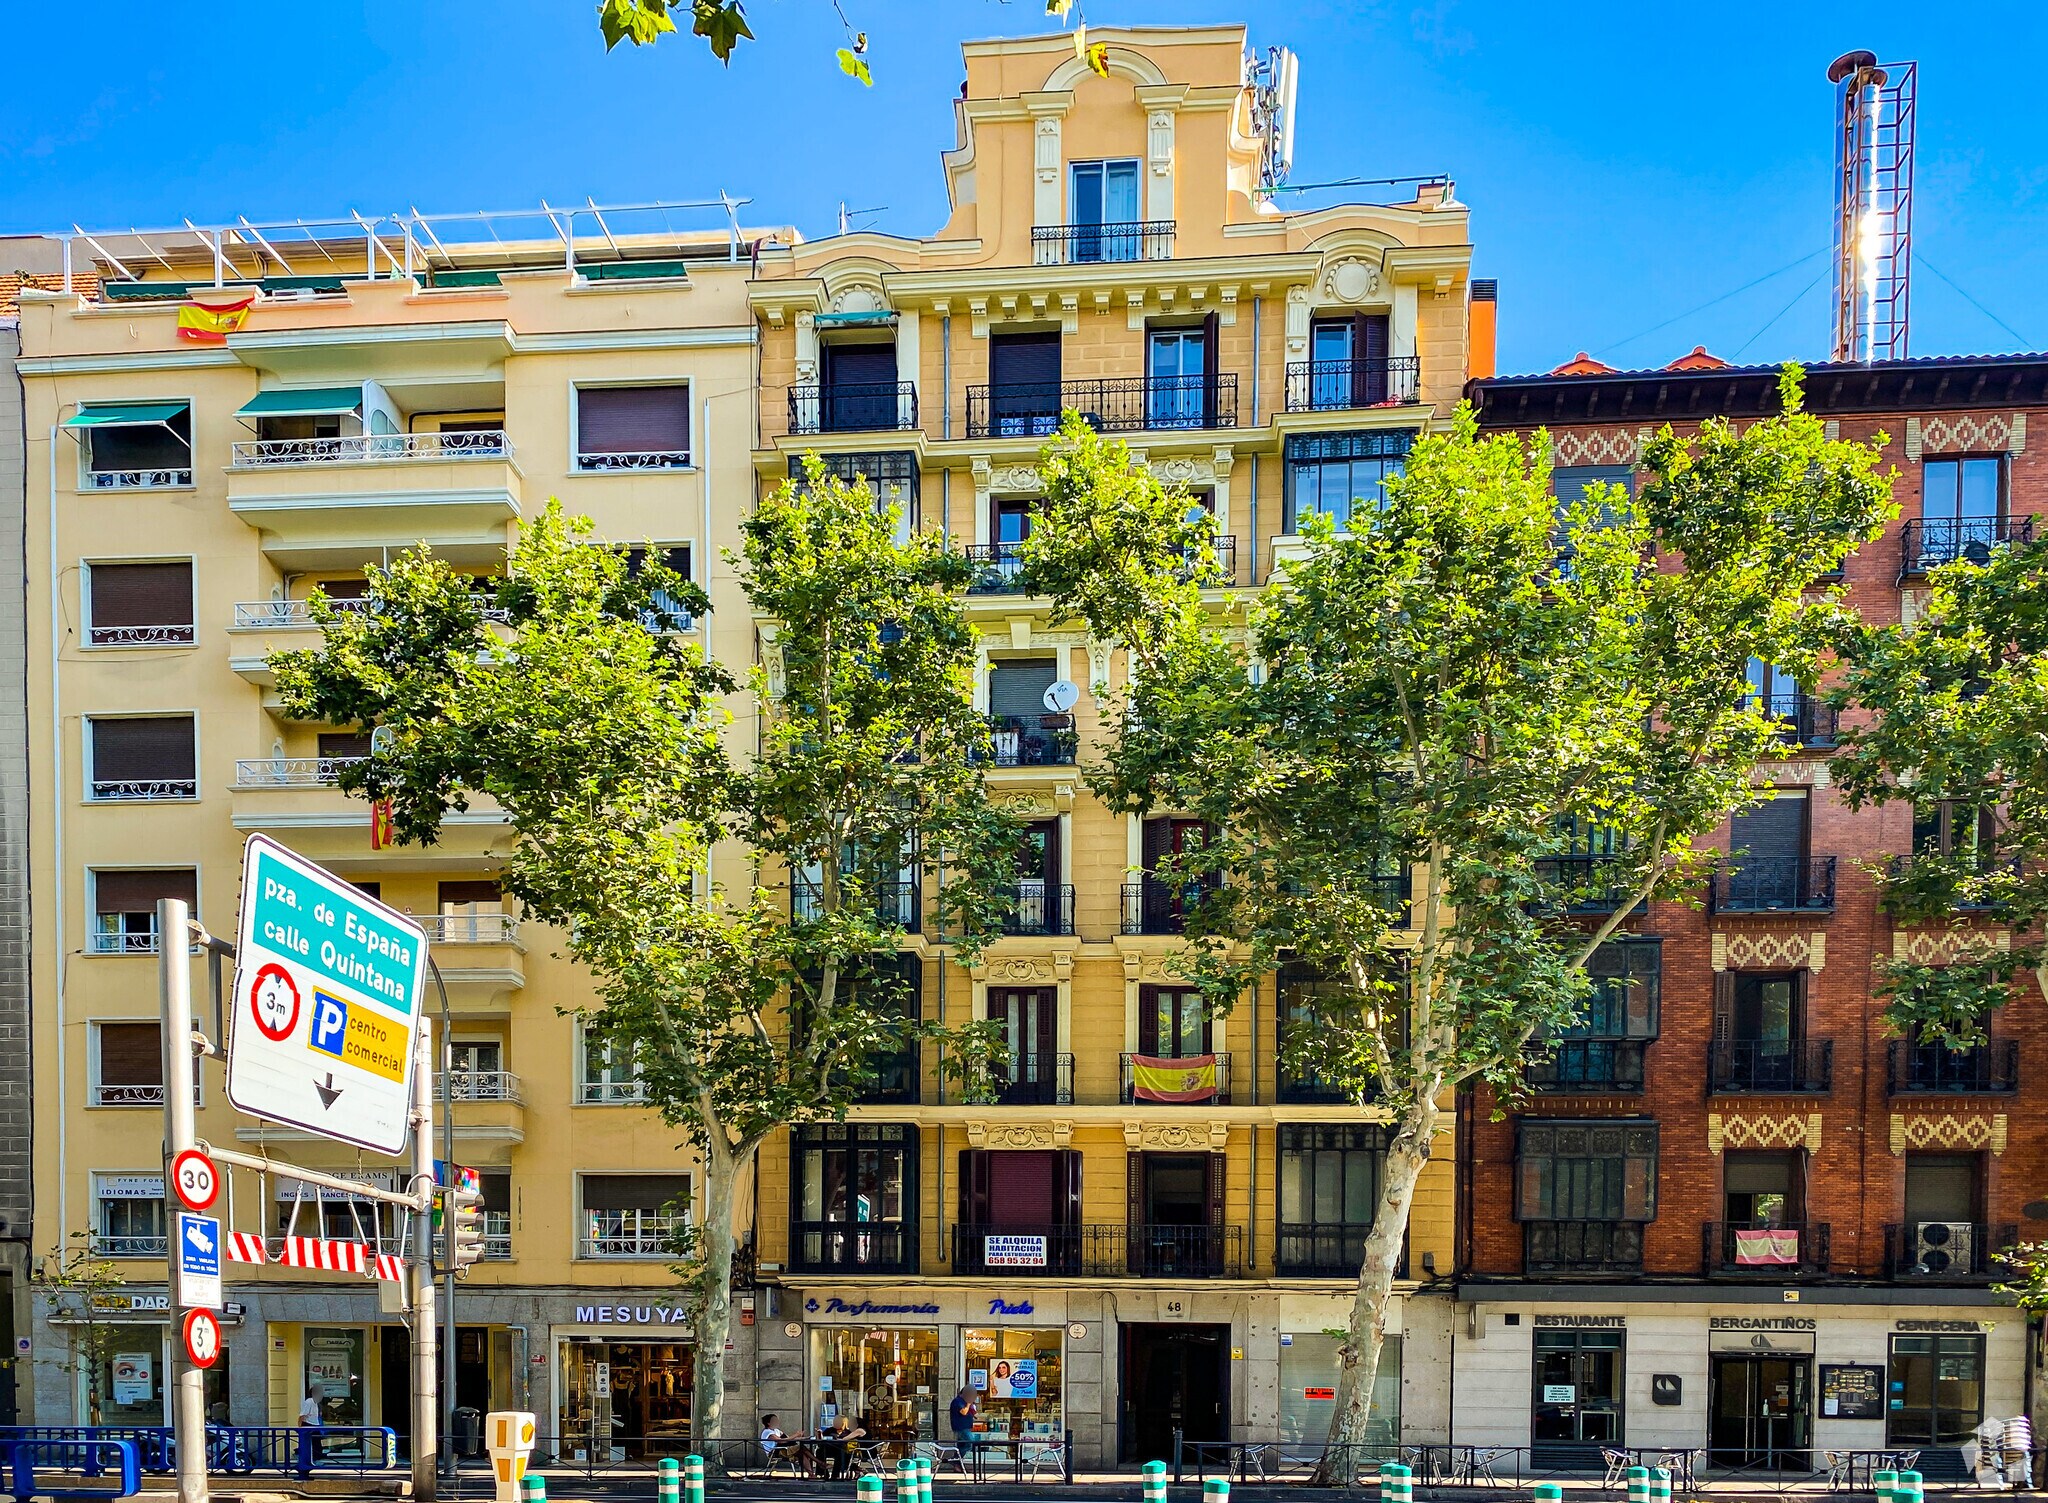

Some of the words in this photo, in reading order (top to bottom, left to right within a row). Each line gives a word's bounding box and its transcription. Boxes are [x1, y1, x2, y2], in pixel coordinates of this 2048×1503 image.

[265, 877, 302, 912] pza.
[313, 902, 335, 927] de
[344, 911, 410, 967] España
[264, 921, 310, 956] calle
[320, 940, 405, 1002] Quintana
[317, 1000, 344, 1044] P
[350, 1017, 387, 1043] centro
[347, 1043, 403, 1074] comercial
[183, 1170, 209, 1190] 30
[576, 1306, 687, 1323] MESUYA
[988, 1297, 1035, 1316] Prieto
[1167, 1301, 1182, 1312] 48
[1534, 1314, 1626, 1327] RESTAURANTE
[1709, 1316, 1817, 1330] BERGANTIÑOS
[1895, 1320, 1981, 1332] CERVECERIA
